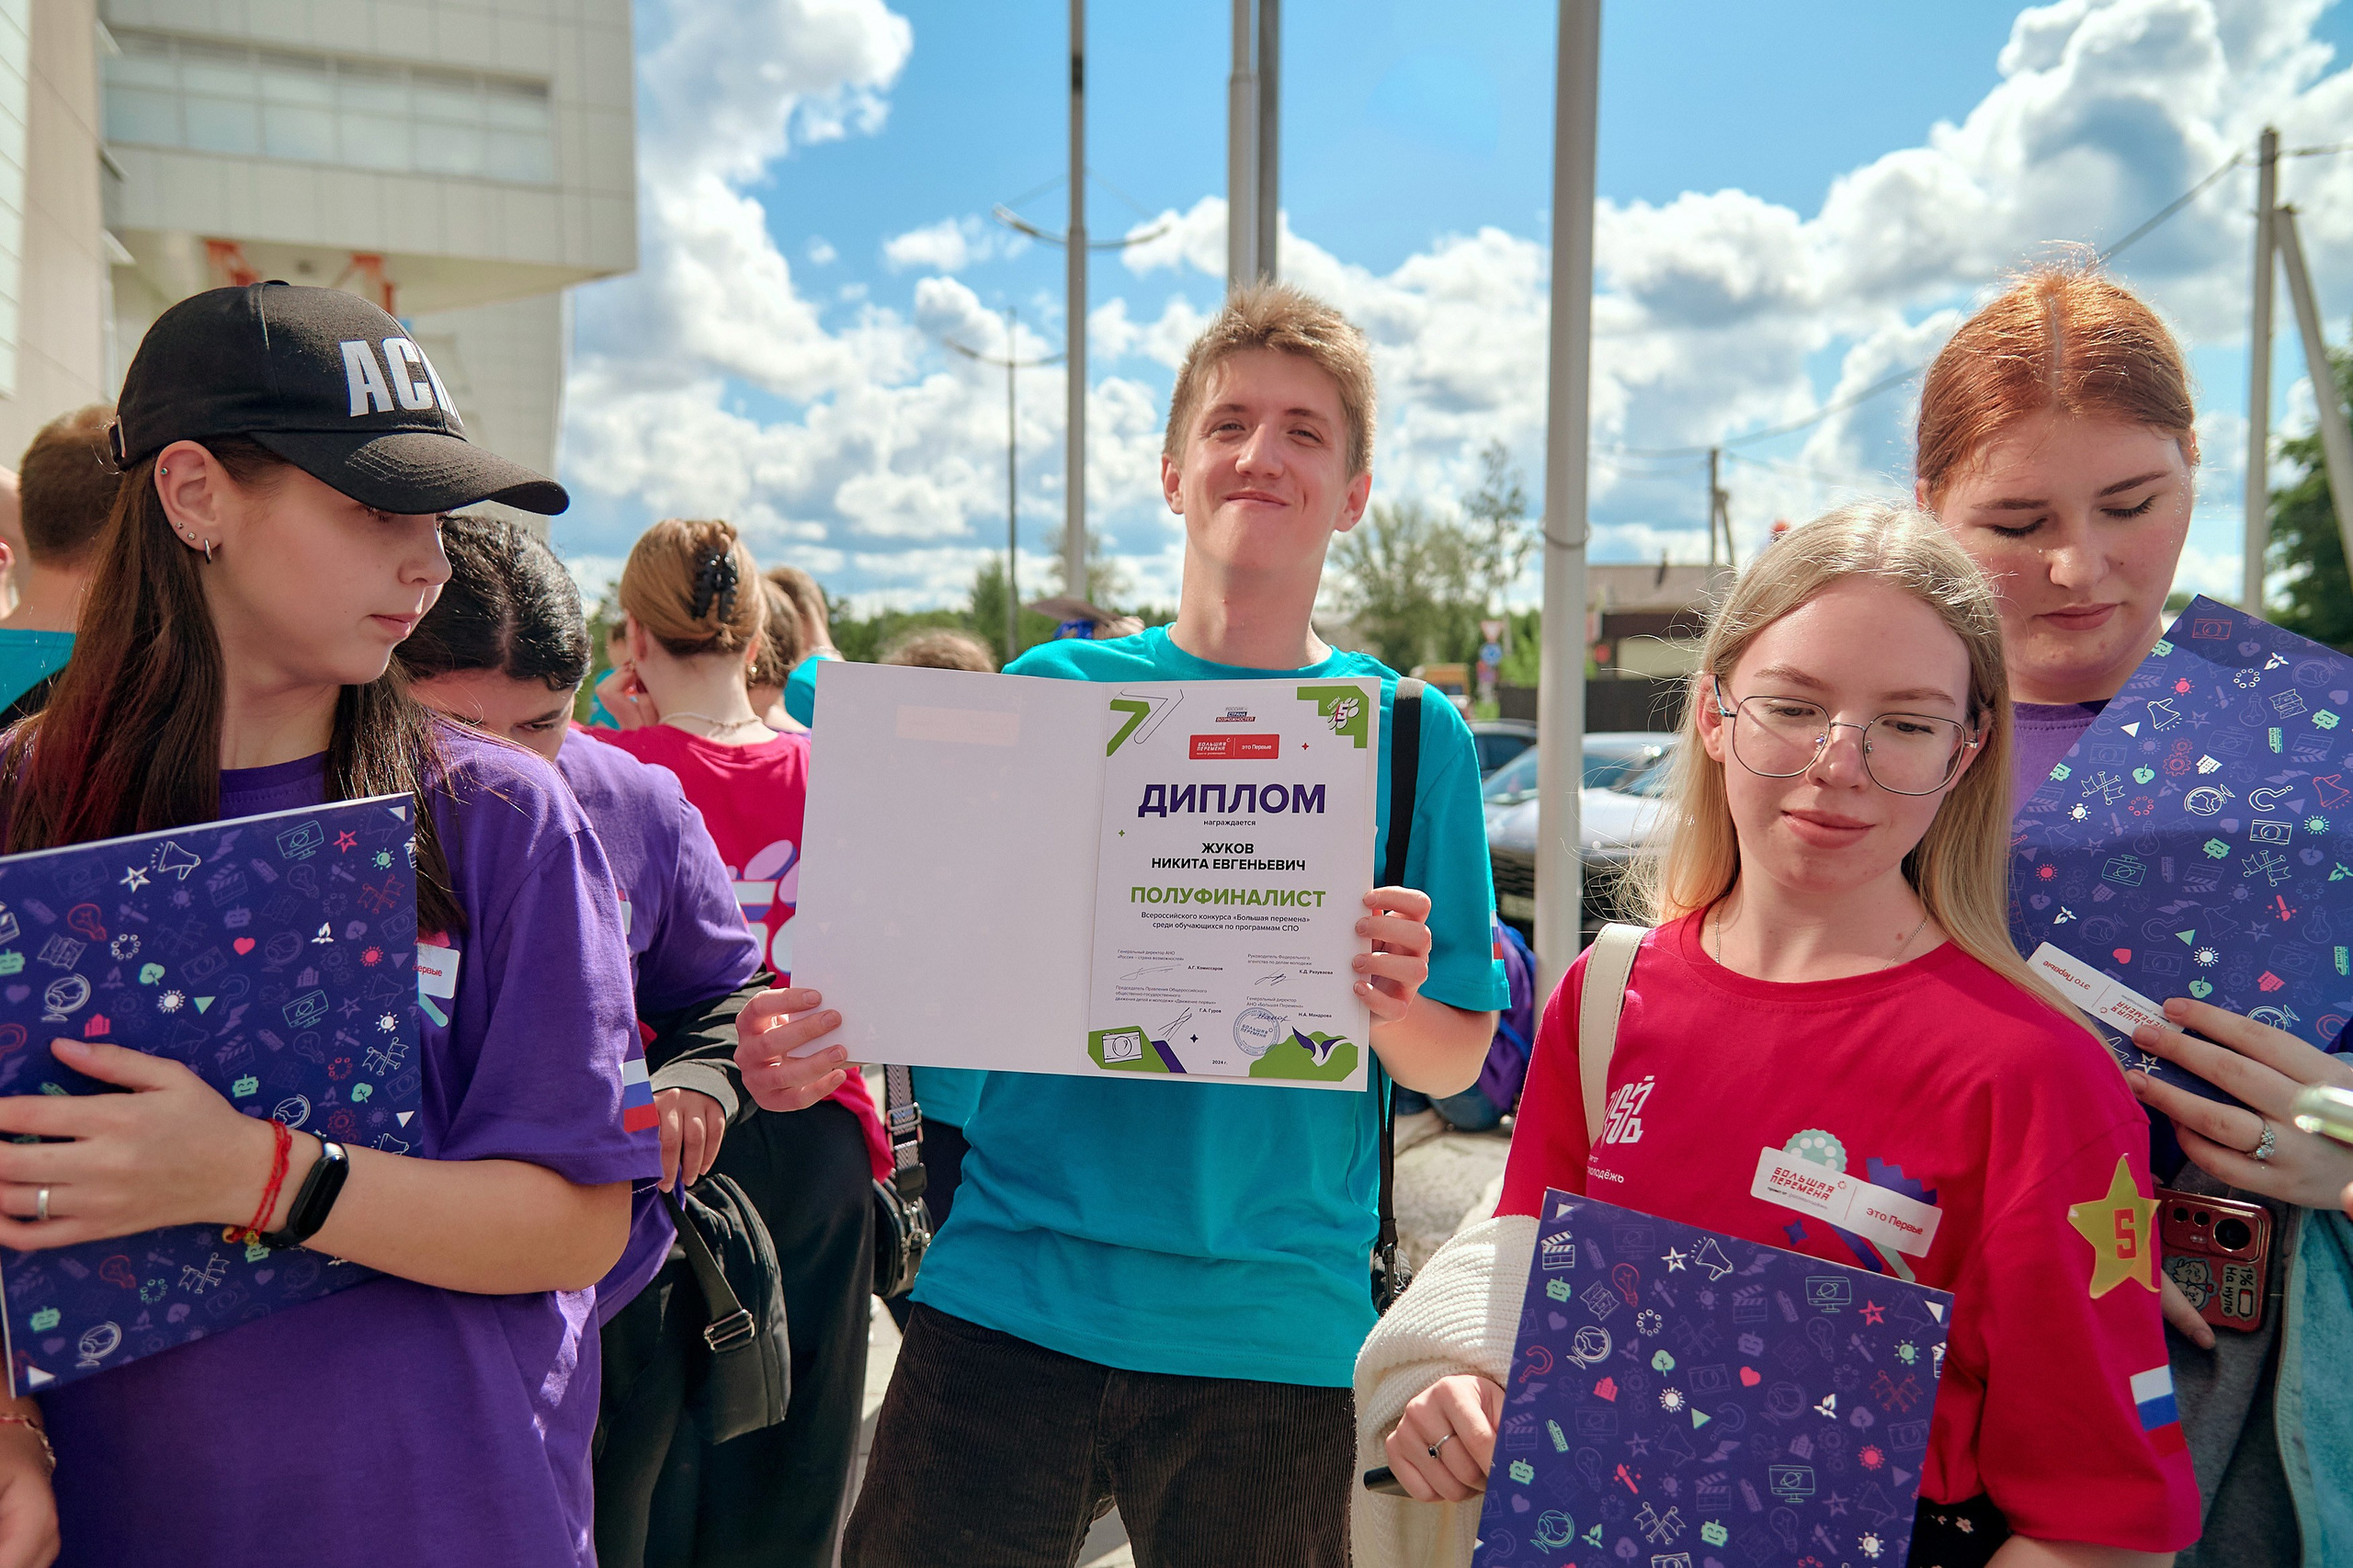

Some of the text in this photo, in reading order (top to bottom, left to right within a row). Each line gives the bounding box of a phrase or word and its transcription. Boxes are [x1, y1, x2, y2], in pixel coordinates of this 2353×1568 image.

[1138, 784, 1326, 817] ДИПЛОМ
[1201, 843, 1255, 855] ЖУКОВ
[1151, 858, 1306, 871] НИКИТА ЕВГЕНЬЕВИЧ
[1131, 887, 1326, 907] ПОЛУФИНАЛИСТ
[1141, 912, 1198, 920] Всероссийского
[1233, 914, 1269, 922] «Большая
[417, 965, 443, 976] ервые
[2042, 960, 2091, 990] это Первые
[2110, 1006, 2144, 1025] ЬШАЯ
[1769, 1175, 1830, 1201] ПЕРЕМЕНА
[1774, 1166, 1836, 1194] БОЛЬШАЯ
[1866, 1208, 1924, 1235] это Первые
[2240, 1268, 2254, 1286] 1%
[2222, 1267, 2237, 1313] На нуле
